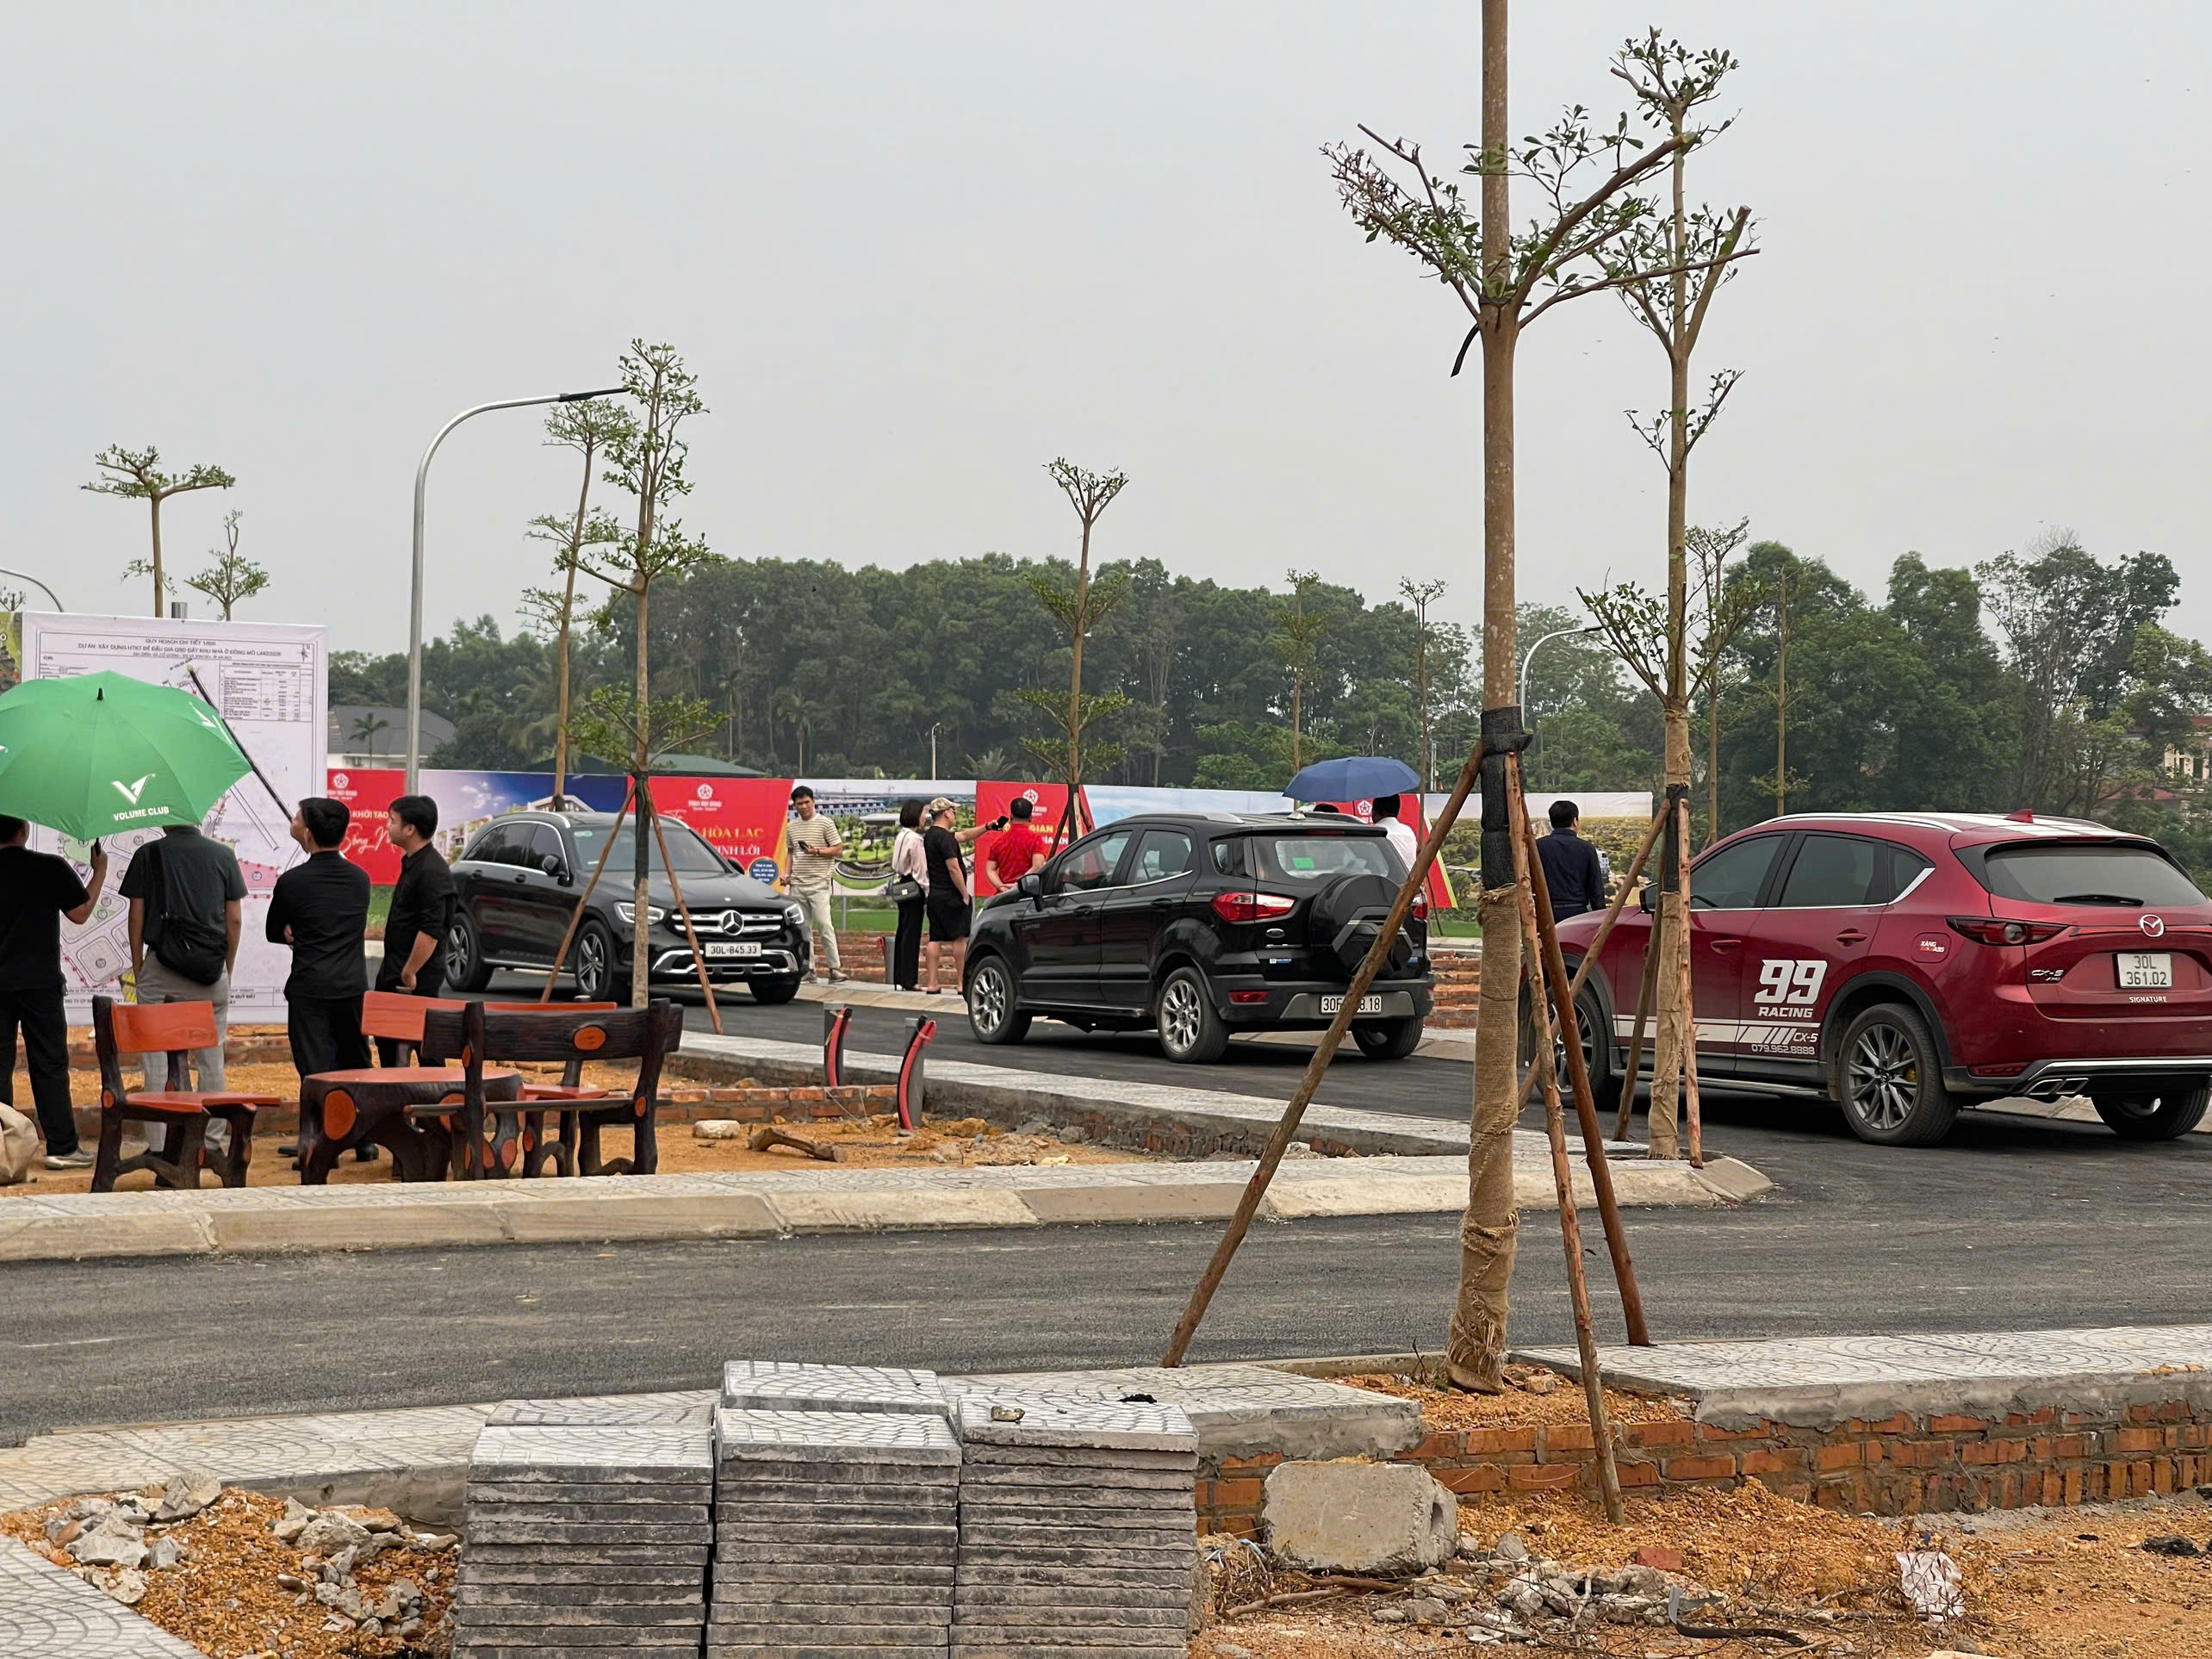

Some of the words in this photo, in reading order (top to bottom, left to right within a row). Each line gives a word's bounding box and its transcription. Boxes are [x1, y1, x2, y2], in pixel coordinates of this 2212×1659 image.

[114, 808, 147, 821] VOLUME
[147, 806, 170, 816] CLUB
[352, 809, 373, 818] KHỞI
[374, 811, 389, 820] TẠO
[2134, 955, 2157, 969] 30L
[1754, 959, 1828, 1004] 99
[2127, 971, 2167, 985] 361.02
[1758, 1006, 1814, 1018] RACING
[1793, 1032, 1819, 1042] CX-5
[1751, 1044, 1815, 1055] 079.962.8888
